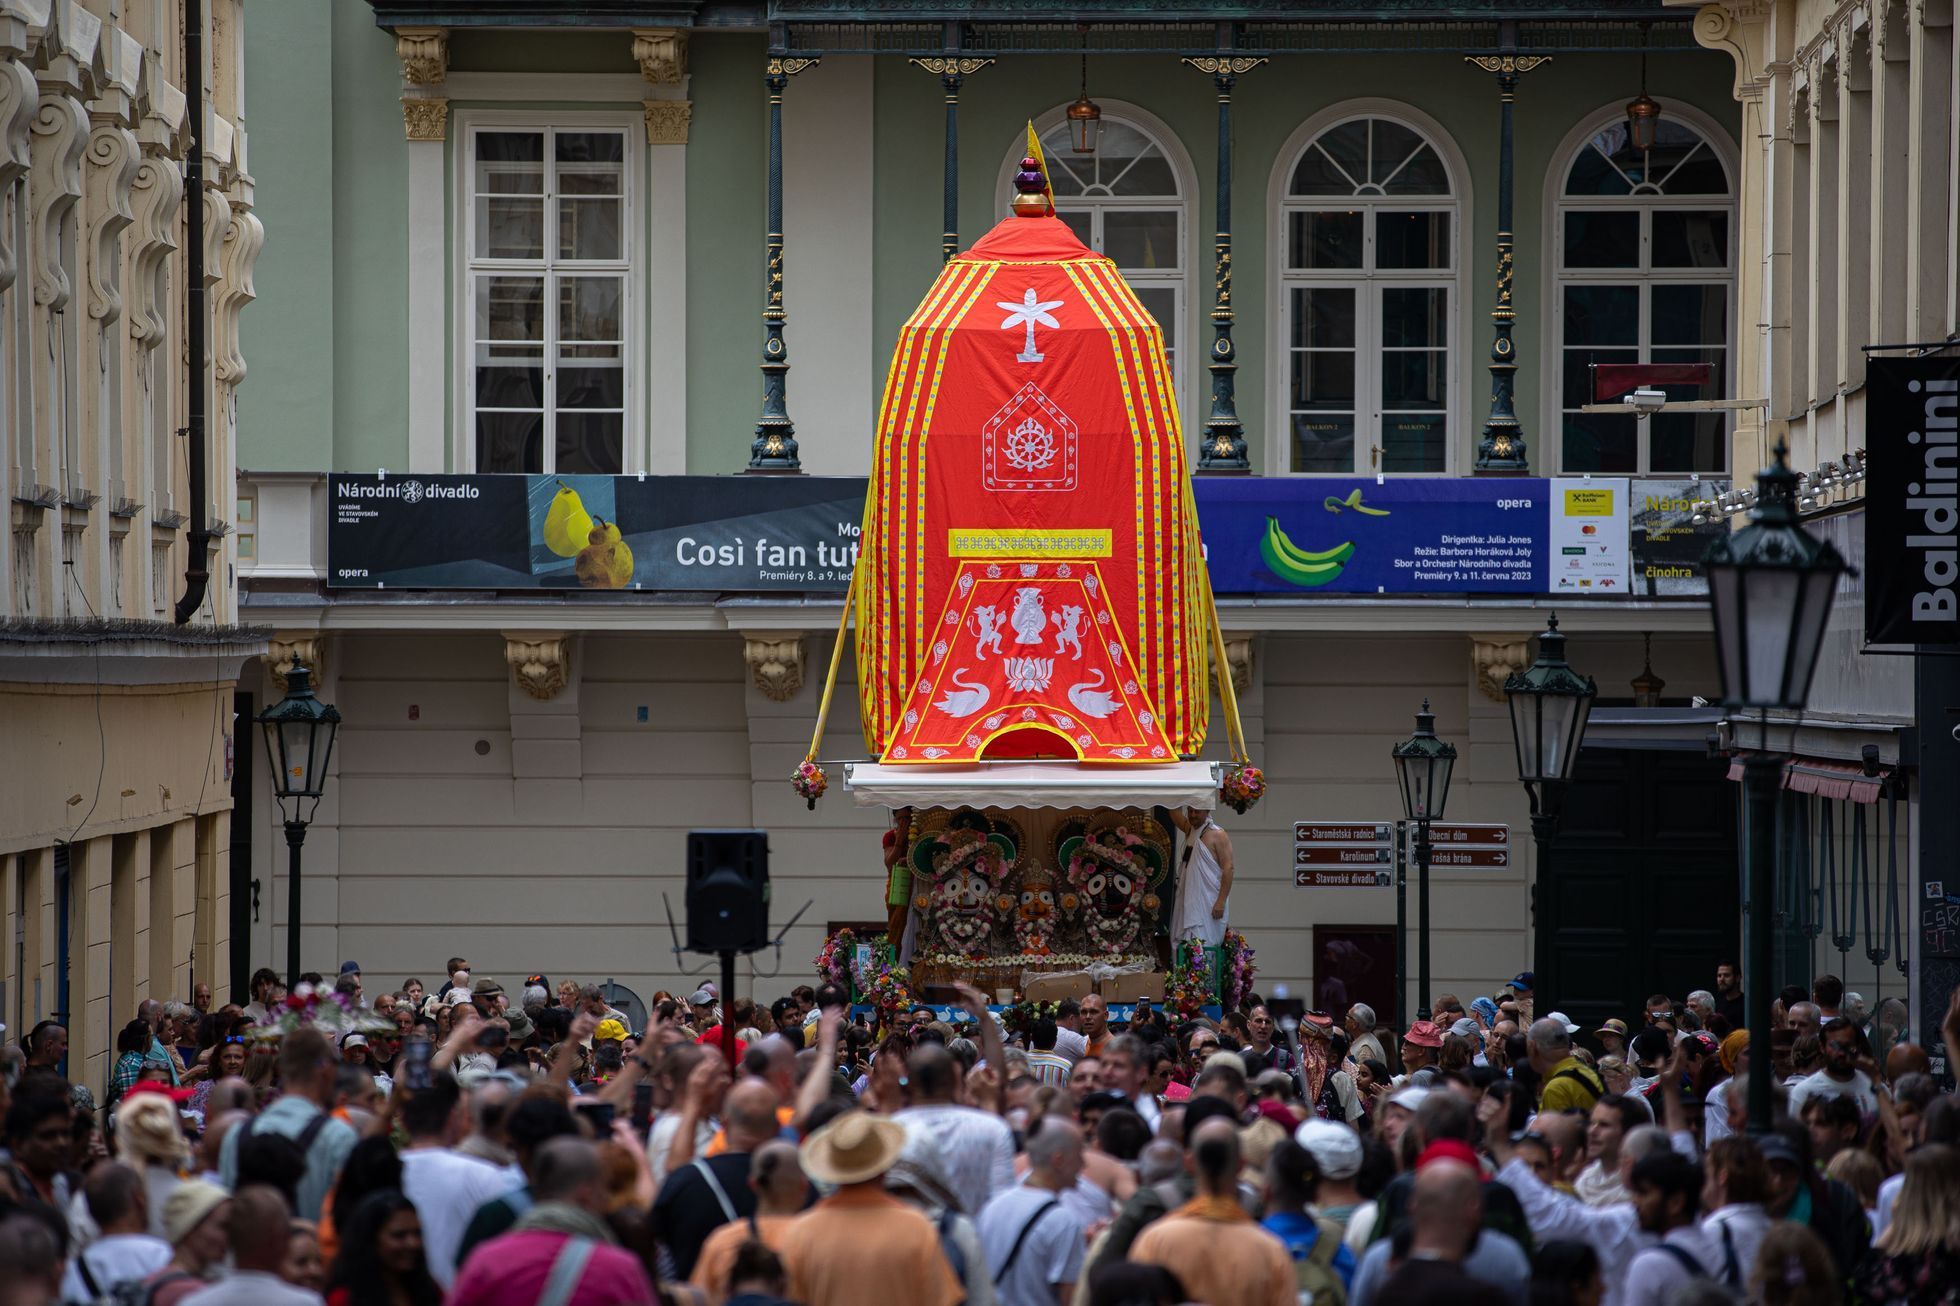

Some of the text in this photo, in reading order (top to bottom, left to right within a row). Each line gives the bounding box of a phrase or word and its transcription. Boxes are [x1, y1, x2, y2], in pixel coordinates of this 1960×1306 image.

[338, 483, 480, 499] Národní divadlo
[1497, 499, 1532, 510] opera
[1906, 379, 1958, 622] Baldinini
[338, 503, 361, 511] UVÁDÍME
[838, 522, 861, 537] Mo
[1441, 535, 1532, 545] Dirigentka: Julia Jones
[676, 537, 744, 566] Così
[755, 538, 806, 567] fan
[1414, 547, 1532, 558] Režie: Barbora Horáková Joly
[1394, 559, 1414, 568] Sbor
[1422, 559, 1457, 568] Orchestr
[1459, 559, 1501, 568] Národního
[1502, 559, 1532, 568] divadla
[338, 568, 369, 579] opera
[760, 570, 805, 582] Premiéry
[807, 571, 817, 581] 8.
[827, 571, 836, 581] 9.
[1414, 571, 1452, 582] Premiéry
[1453, 571, 1461, 580] 9.
[1470, 571, 1481, 580] 11.
[1481, 571, 1510, 580] června
[1511, 571, 1532, 580] 2023
[1646, 566, 1693, 578] činohra
[1312, 829, 1375, 839] Staroměstská radnice
[1428, 829, 1468, 841] Obecní dům
[1340, 850, 1375, 862] Karolinum
[1432, 852, 1472, 863] rašná brána
[1315, 873, 1375, 884] Stavovské divadlo
